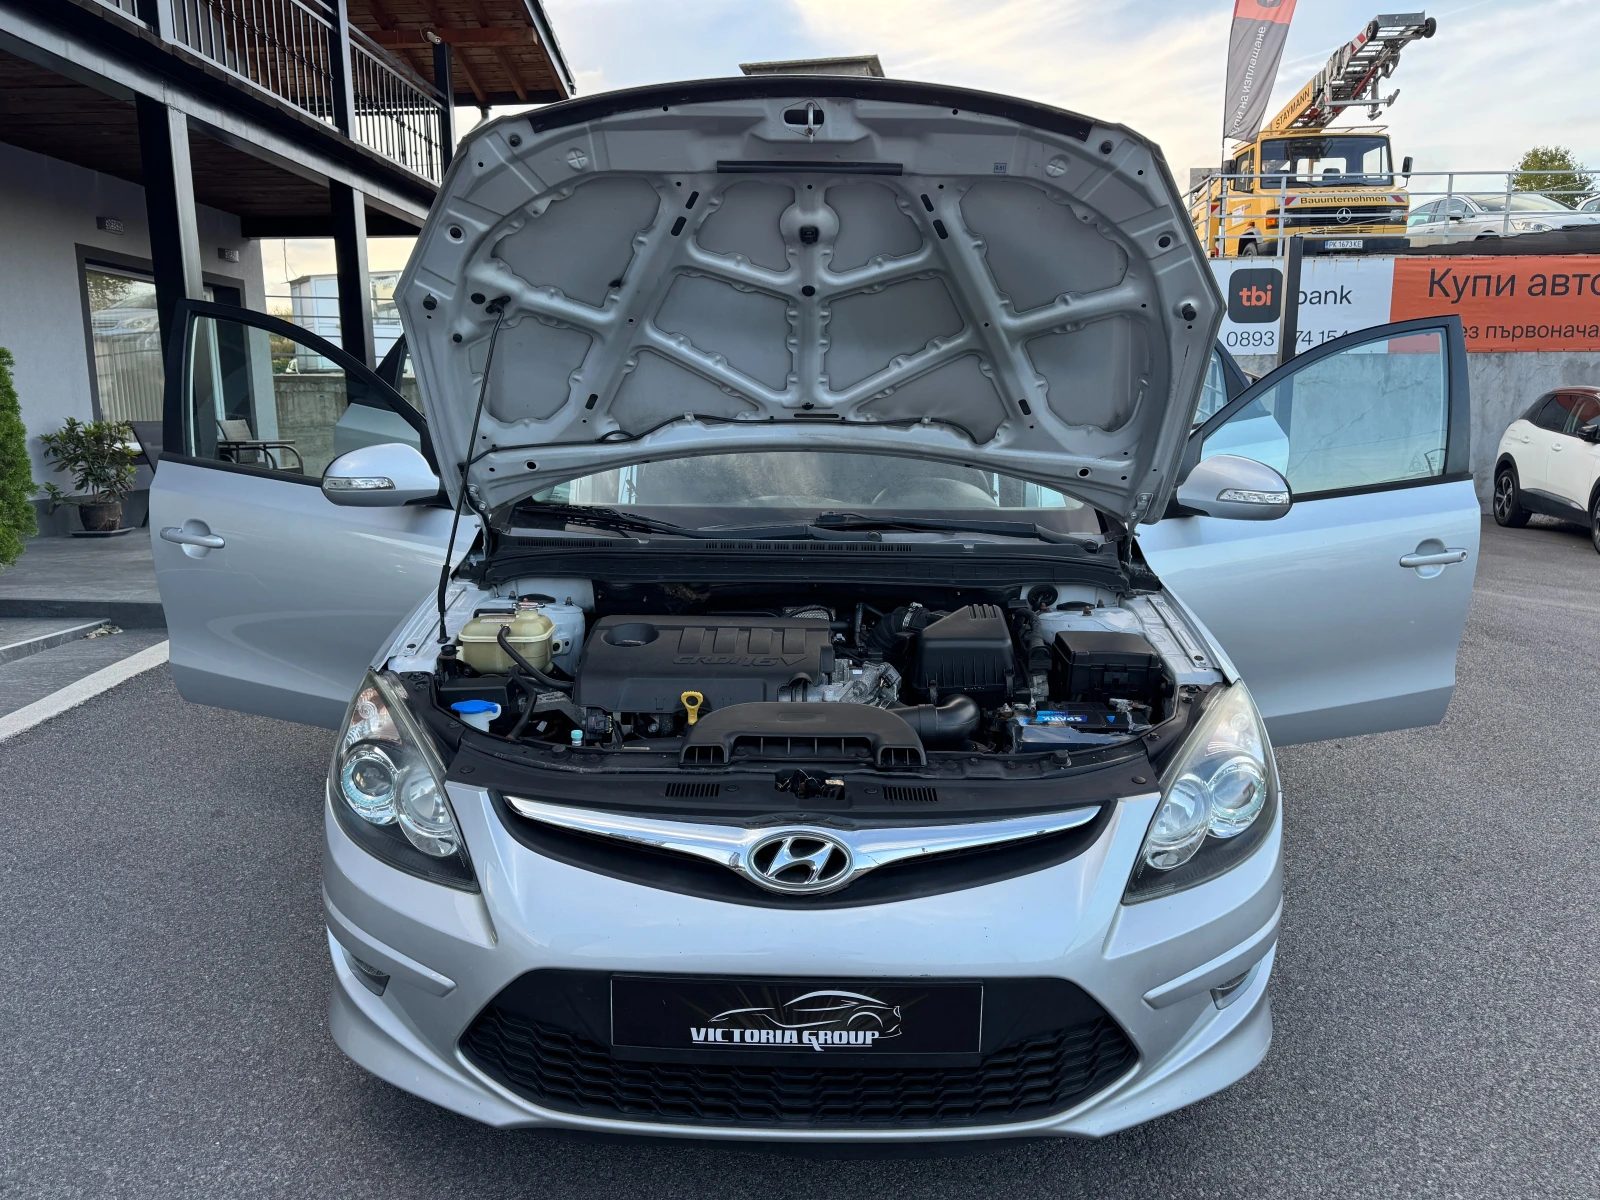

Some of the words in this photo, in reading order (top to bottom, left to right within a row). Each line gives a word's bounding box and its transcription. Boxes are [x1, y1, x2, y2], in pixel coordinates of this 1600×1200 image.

[1242, 26, 1266, 93] изплащане
[1240, 95, 1249, 109] на
[1275, 88, 1310, 129] STAYMANN
[1300, 195, 1387, 204] Bauunternehmen
[1239, 284, 1272, 307] tbi
[1428, 268, 1516, 304] Купи
[1226, 330, 1275, 347] 0893
[1485, 324, 1600, 342] първонача
[690, 1027, 798, 1044] VICTORIA
[802, 1030, 879, 1051] GROUP
